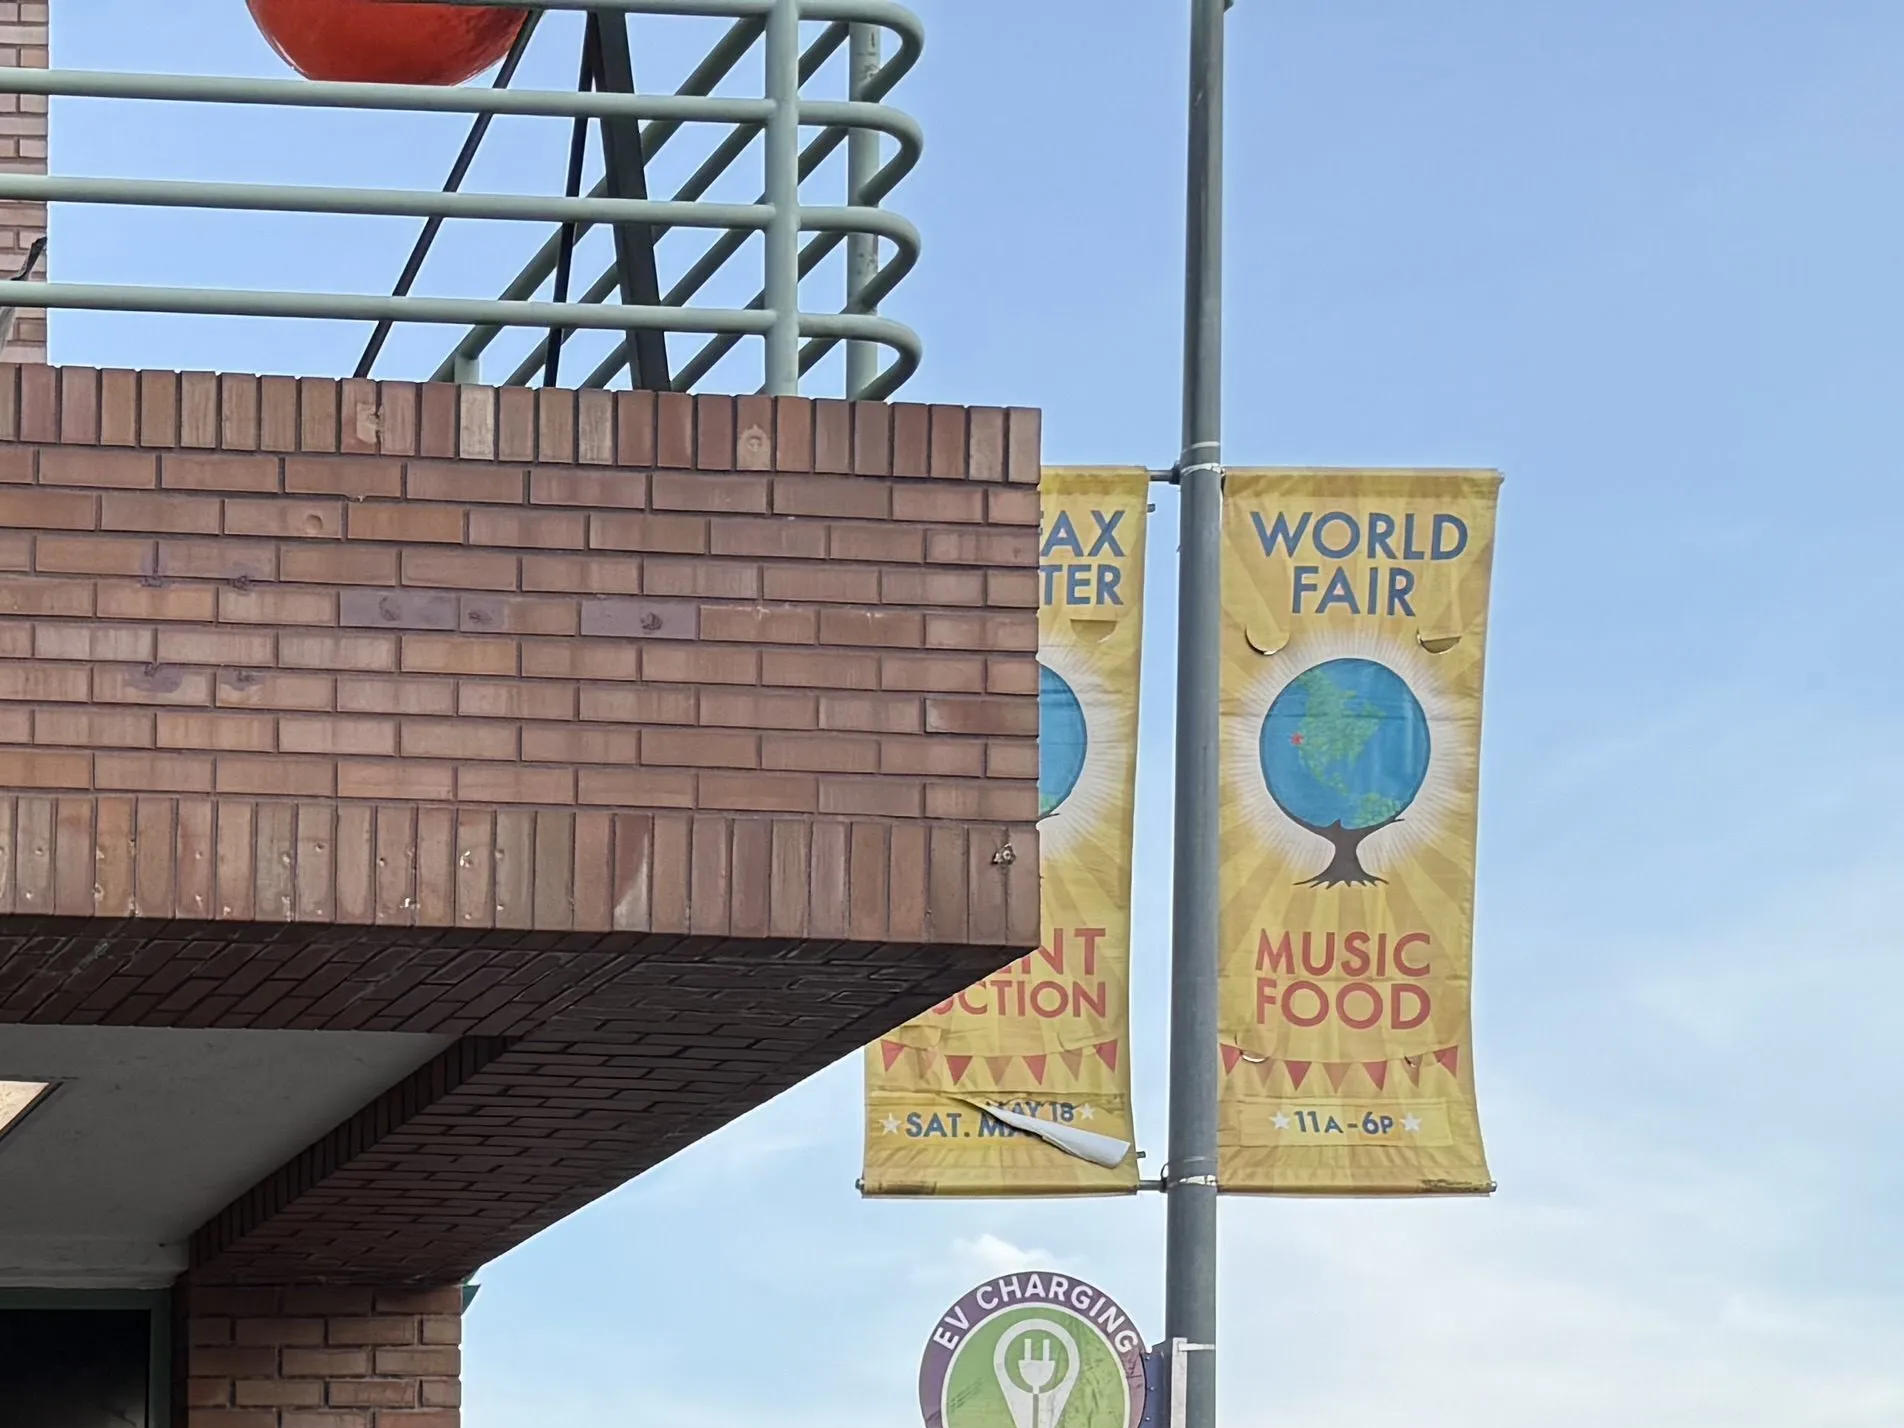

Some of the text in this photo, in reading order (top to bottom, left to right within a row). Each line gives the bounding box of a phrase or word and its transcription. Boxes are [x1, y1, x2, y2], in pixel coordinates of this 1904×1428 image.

[1250, 510, 1468, 560] WORLD
[1291, 566, 1417, 618] FAIR
[1255, 928, 1431, 978] MUSIC
[1255, 977, 1432, 1030] FOOD
[905, 1111, 971, 1138] SAT.
[1293, 1110, 1394, 1135] 11A-6P
[933, 1273, 1139, 1354] EV CHARGING
